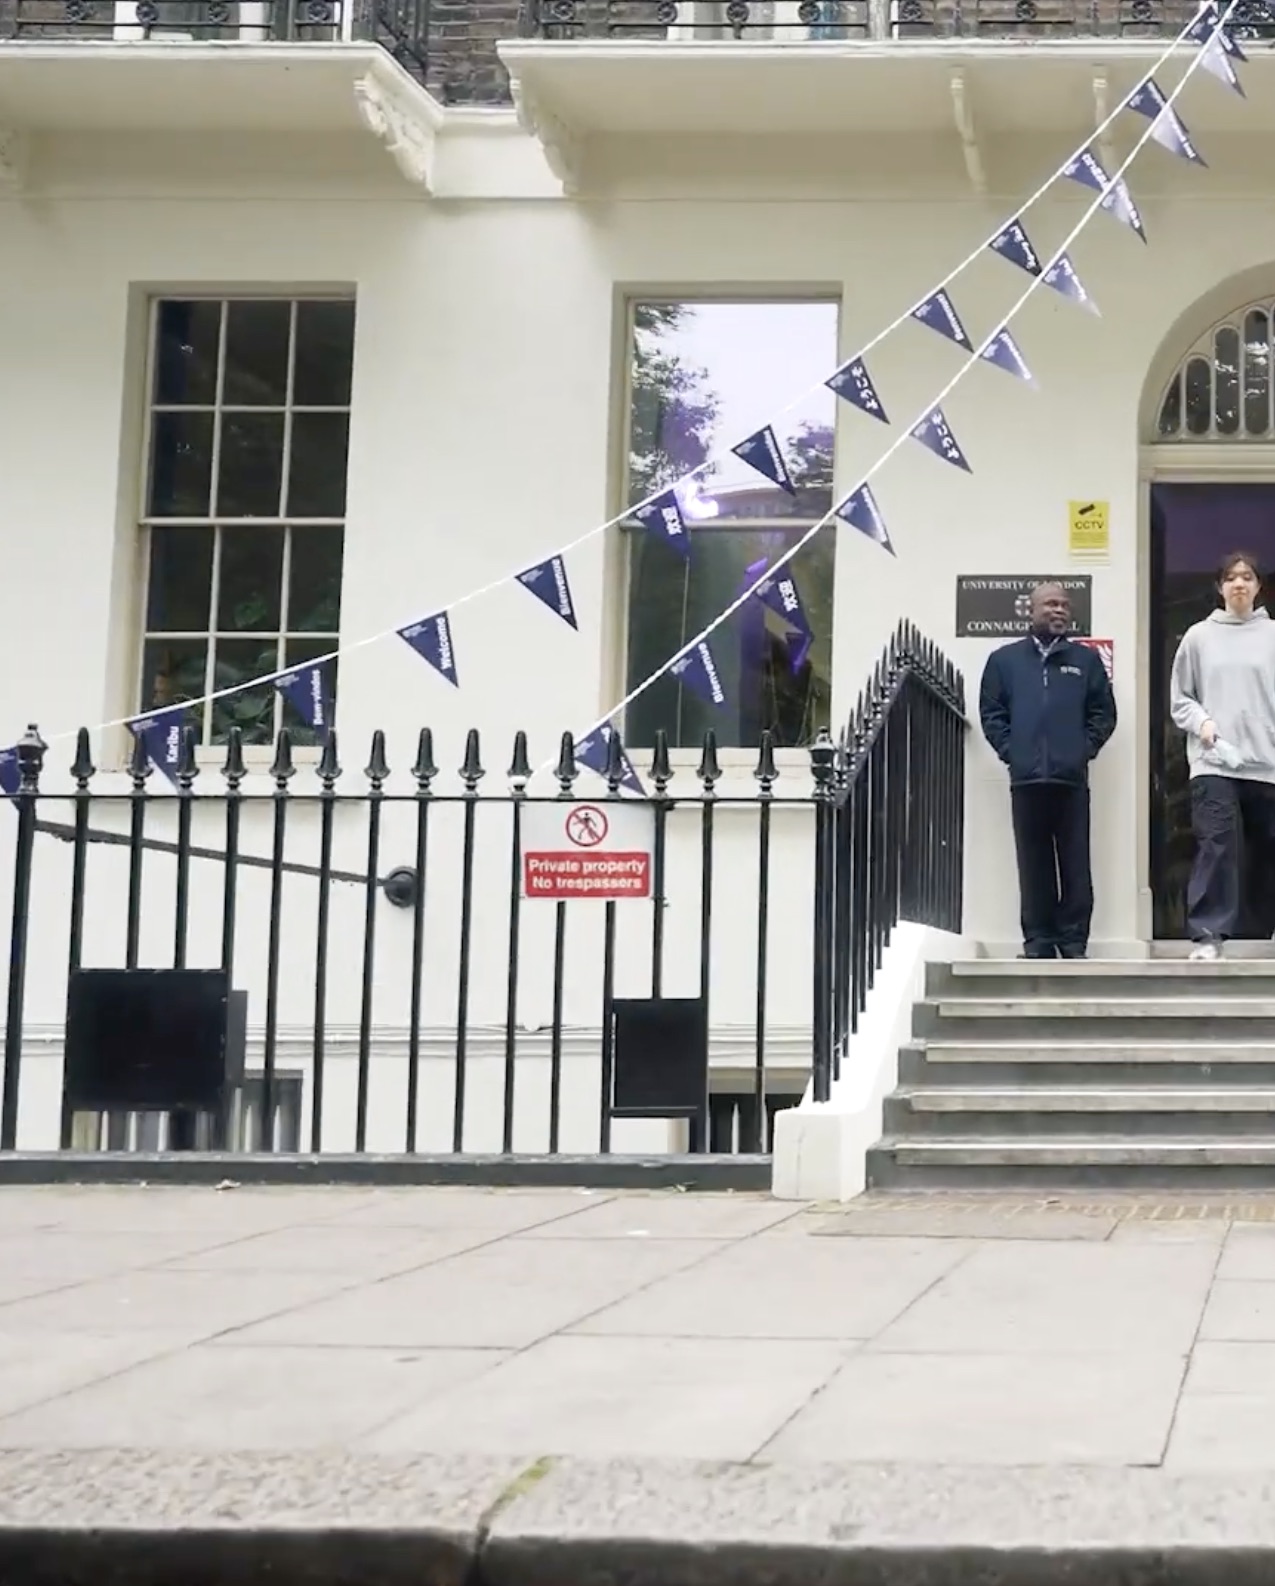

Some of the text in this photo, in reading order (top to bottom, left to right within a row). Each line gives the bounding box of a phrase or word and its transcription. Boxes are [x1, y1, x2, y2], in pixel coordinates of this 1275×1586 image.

[851, 366, 878, 410] ようこそ
[931, 412, 959, 460] ようこそ
[661, 506, 682, 535] 欢迎
[1074, 520, 1104, 530] CCTV
[552, 558, 571, 616] Bienvenue
[778, 579, 798, 612] 欢迎
[962, 581, 1024, 590] UNIVERSITY
[435, 617, 452, 670] Welcome
[698, 643, 724, 704] Bienvenue
[167, 726, 179, 763] Karibu
[528, 859, 647, 875] Private property
[532, 877, 643, 891] No trespassers
